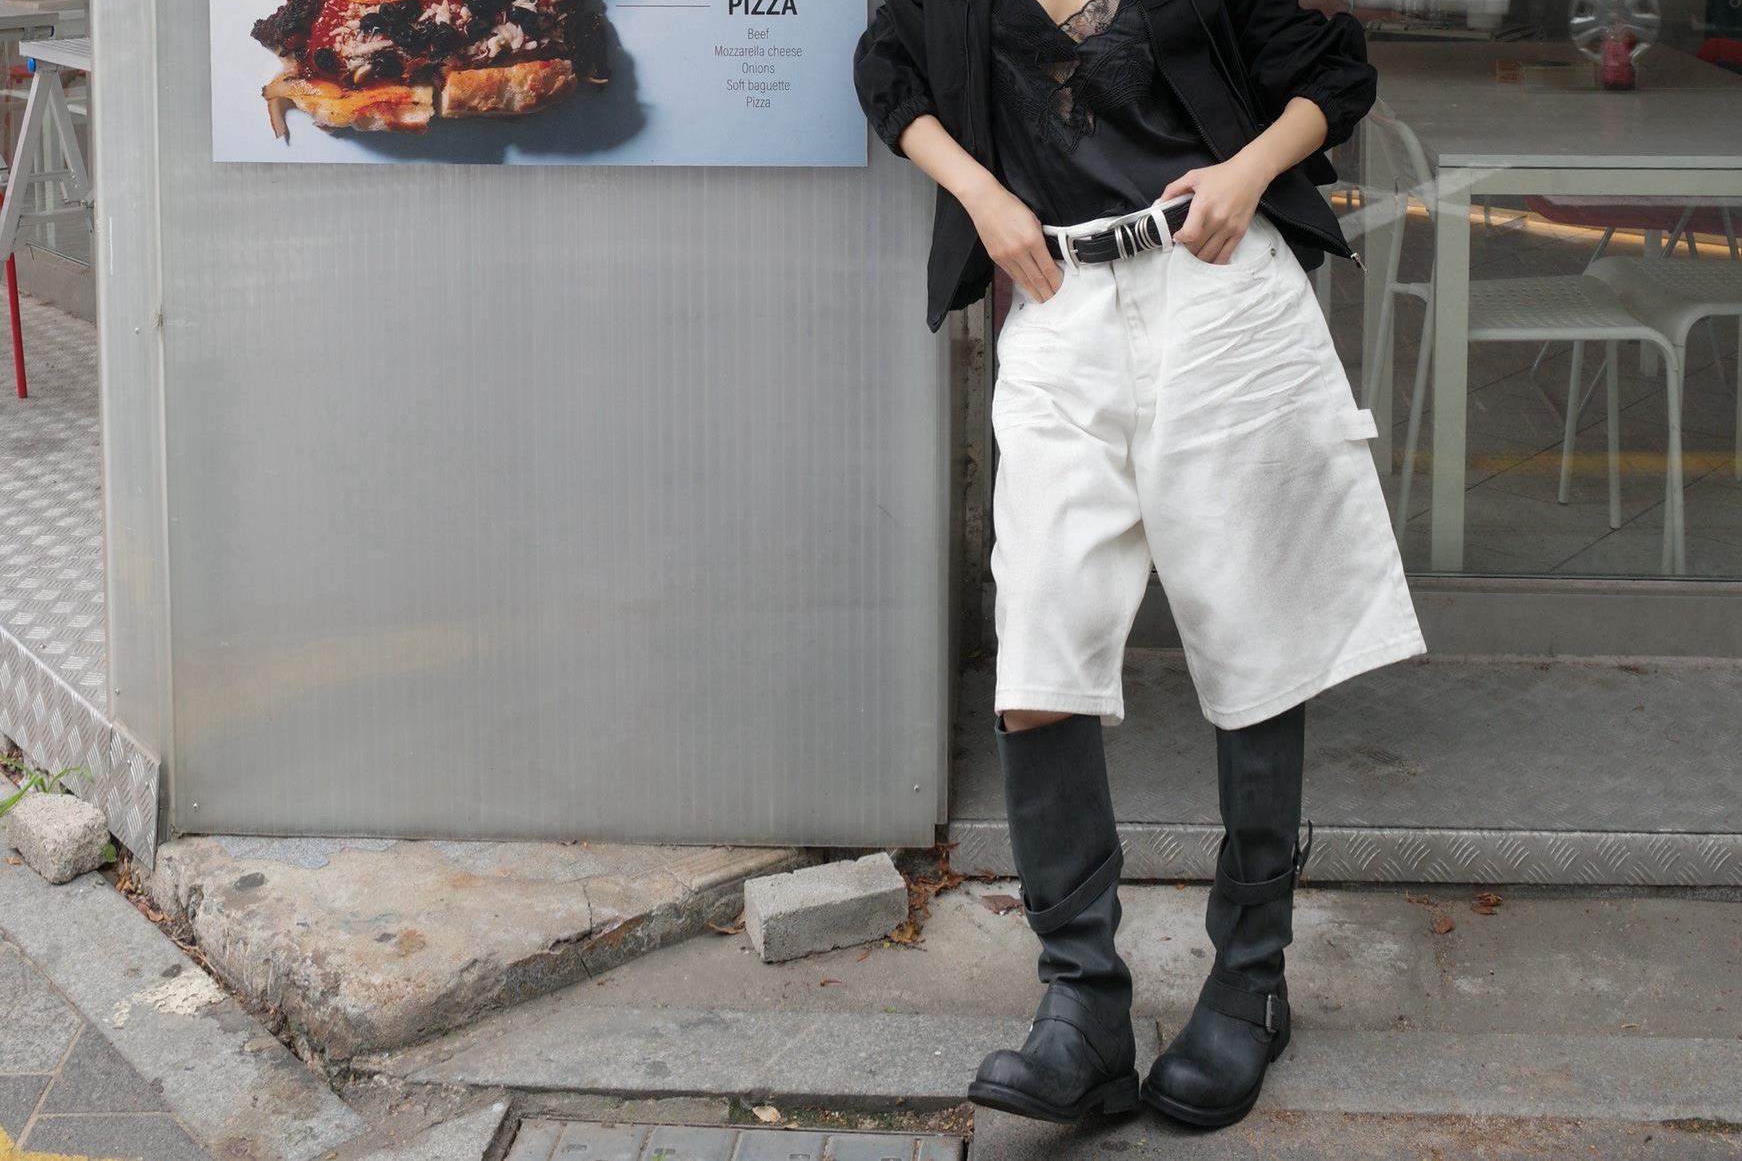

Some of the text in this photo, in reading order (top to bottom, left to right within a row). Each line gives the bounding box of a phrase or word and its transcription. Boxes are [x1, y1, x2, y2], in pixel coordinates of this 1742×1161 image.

[747, 28, 769, 40] Beef
[714, 45, 802, 57] Mozzarella cheese
[742, 62, 775, 74] Onions
[726, 79, 790, 94] Soft baguette
[746, 97, 771, 109] Pizza
